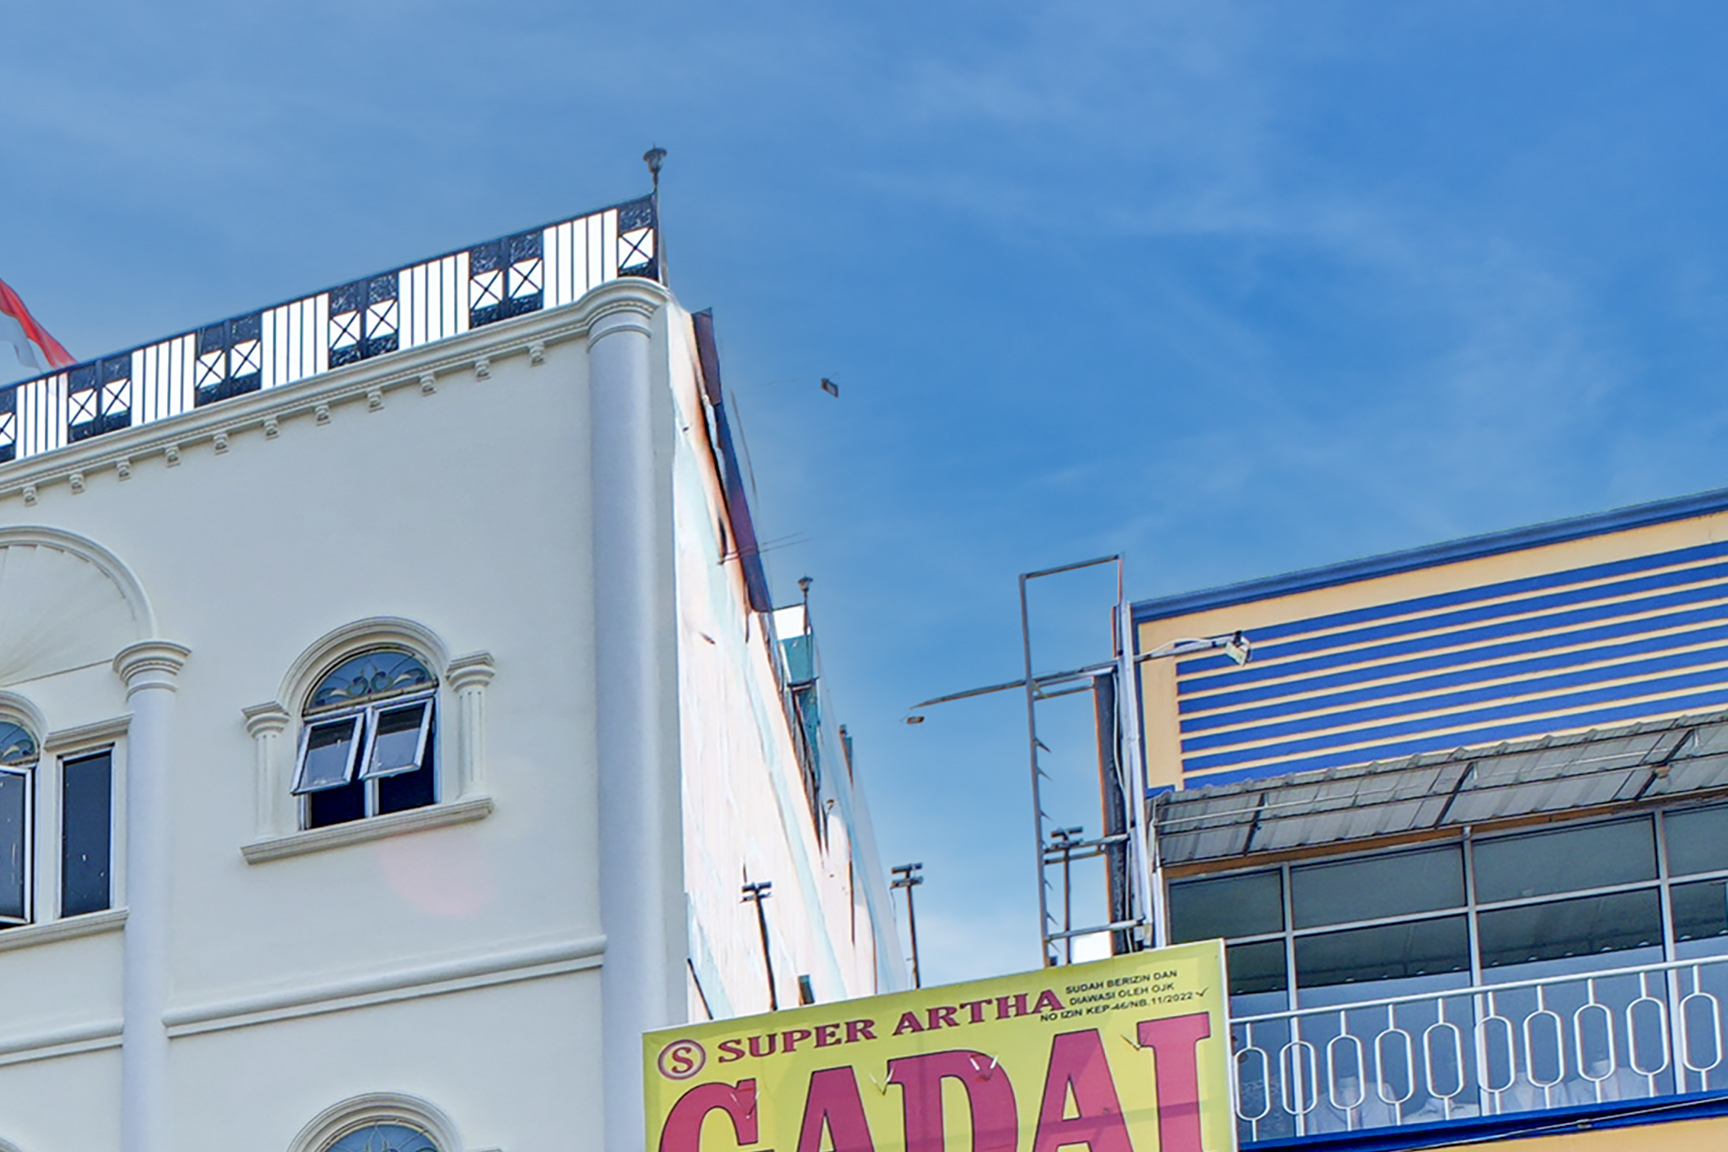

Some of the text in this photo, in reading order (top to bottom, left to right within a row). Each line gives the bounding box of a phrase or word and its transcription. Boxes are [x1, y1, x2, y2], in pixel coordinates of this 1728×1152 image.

[1066, 970, 1177, 994] SUDAH BERIZIN DAN
[1070, 983, 1174, 1005] DIAWASI OLEH OJK
[718, 989, 1065, 1063] SUPER ARTHA
[1040, 1012, 1058, 1022] NO
[1061, 1008, 1083, 1019] IZIN
